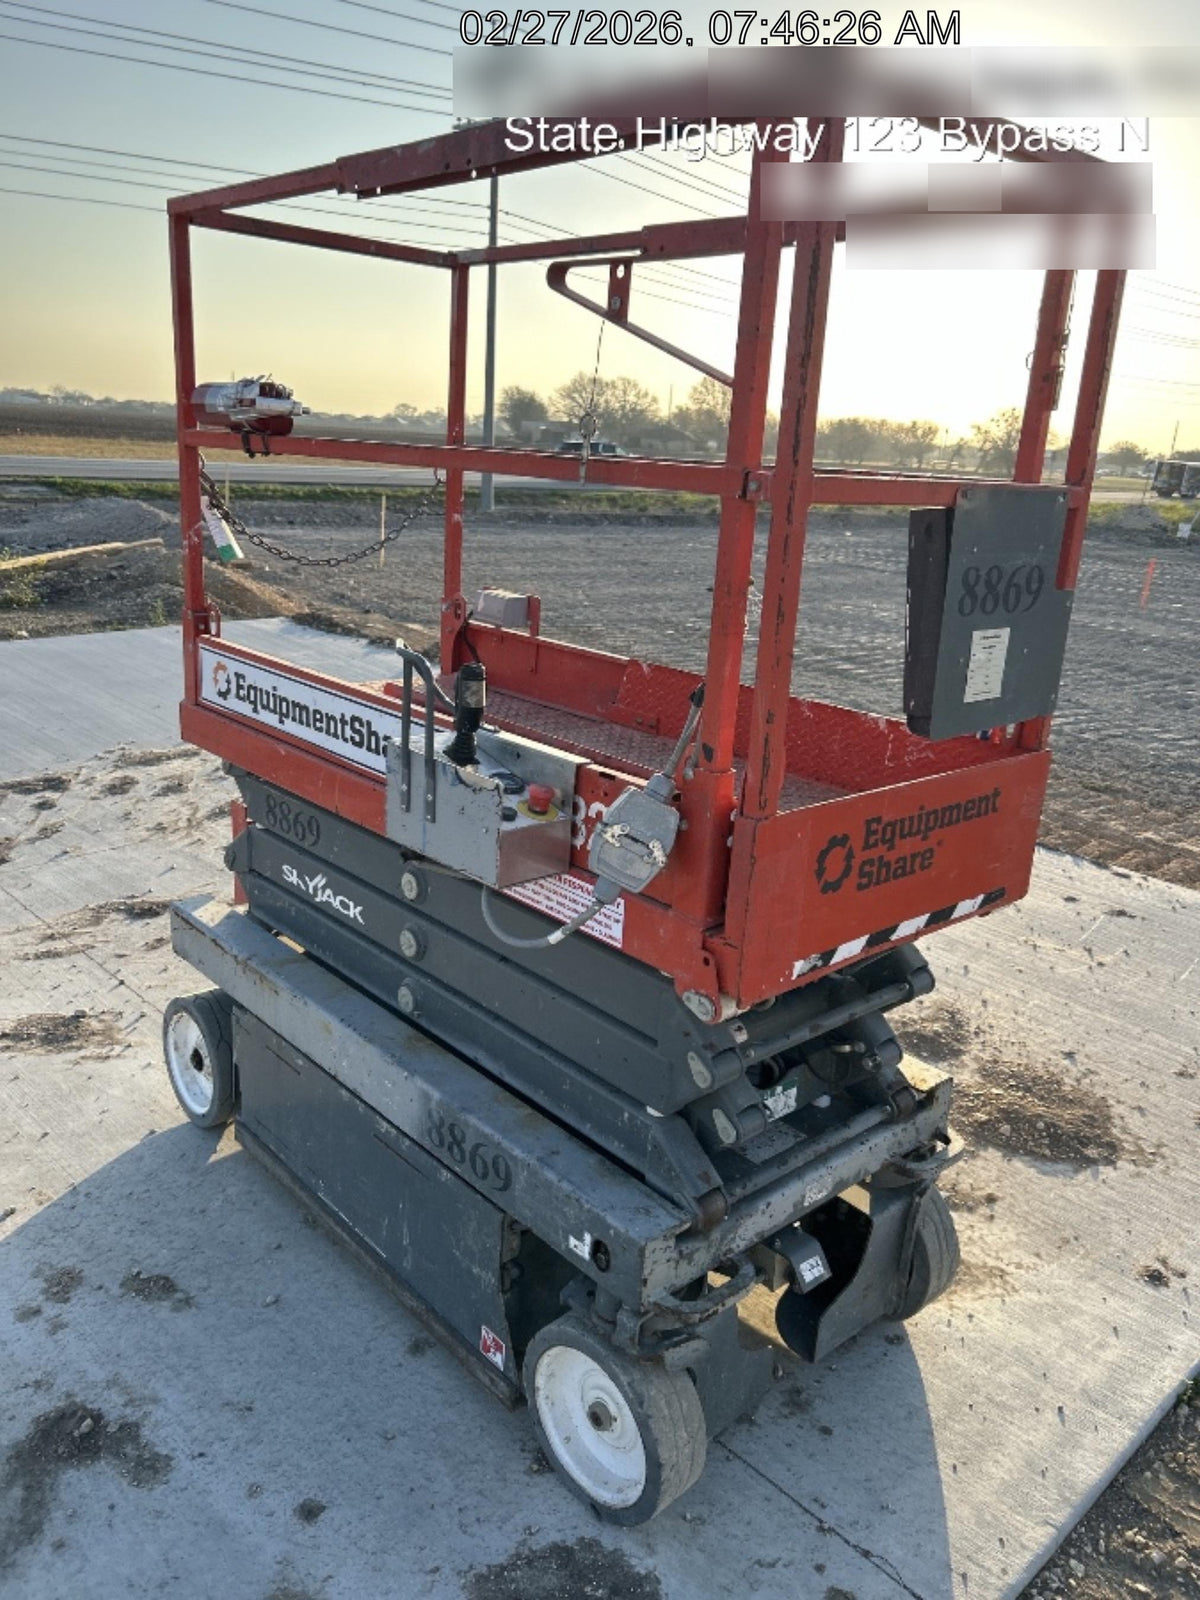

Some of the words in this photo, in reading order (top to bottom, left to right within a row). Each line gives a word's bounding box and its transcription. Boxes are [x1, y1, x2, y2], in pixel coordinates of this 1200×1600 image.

[957, 564, 1045, 617] 8869
[265, 793, 320, 847] 8869
[862, 787, 1002, 851] Equipment
[281, 864, 365, 925] SKYJACK
[856, 847, 934, 891] Share
[426, 1108, 512, 1192] 8869
